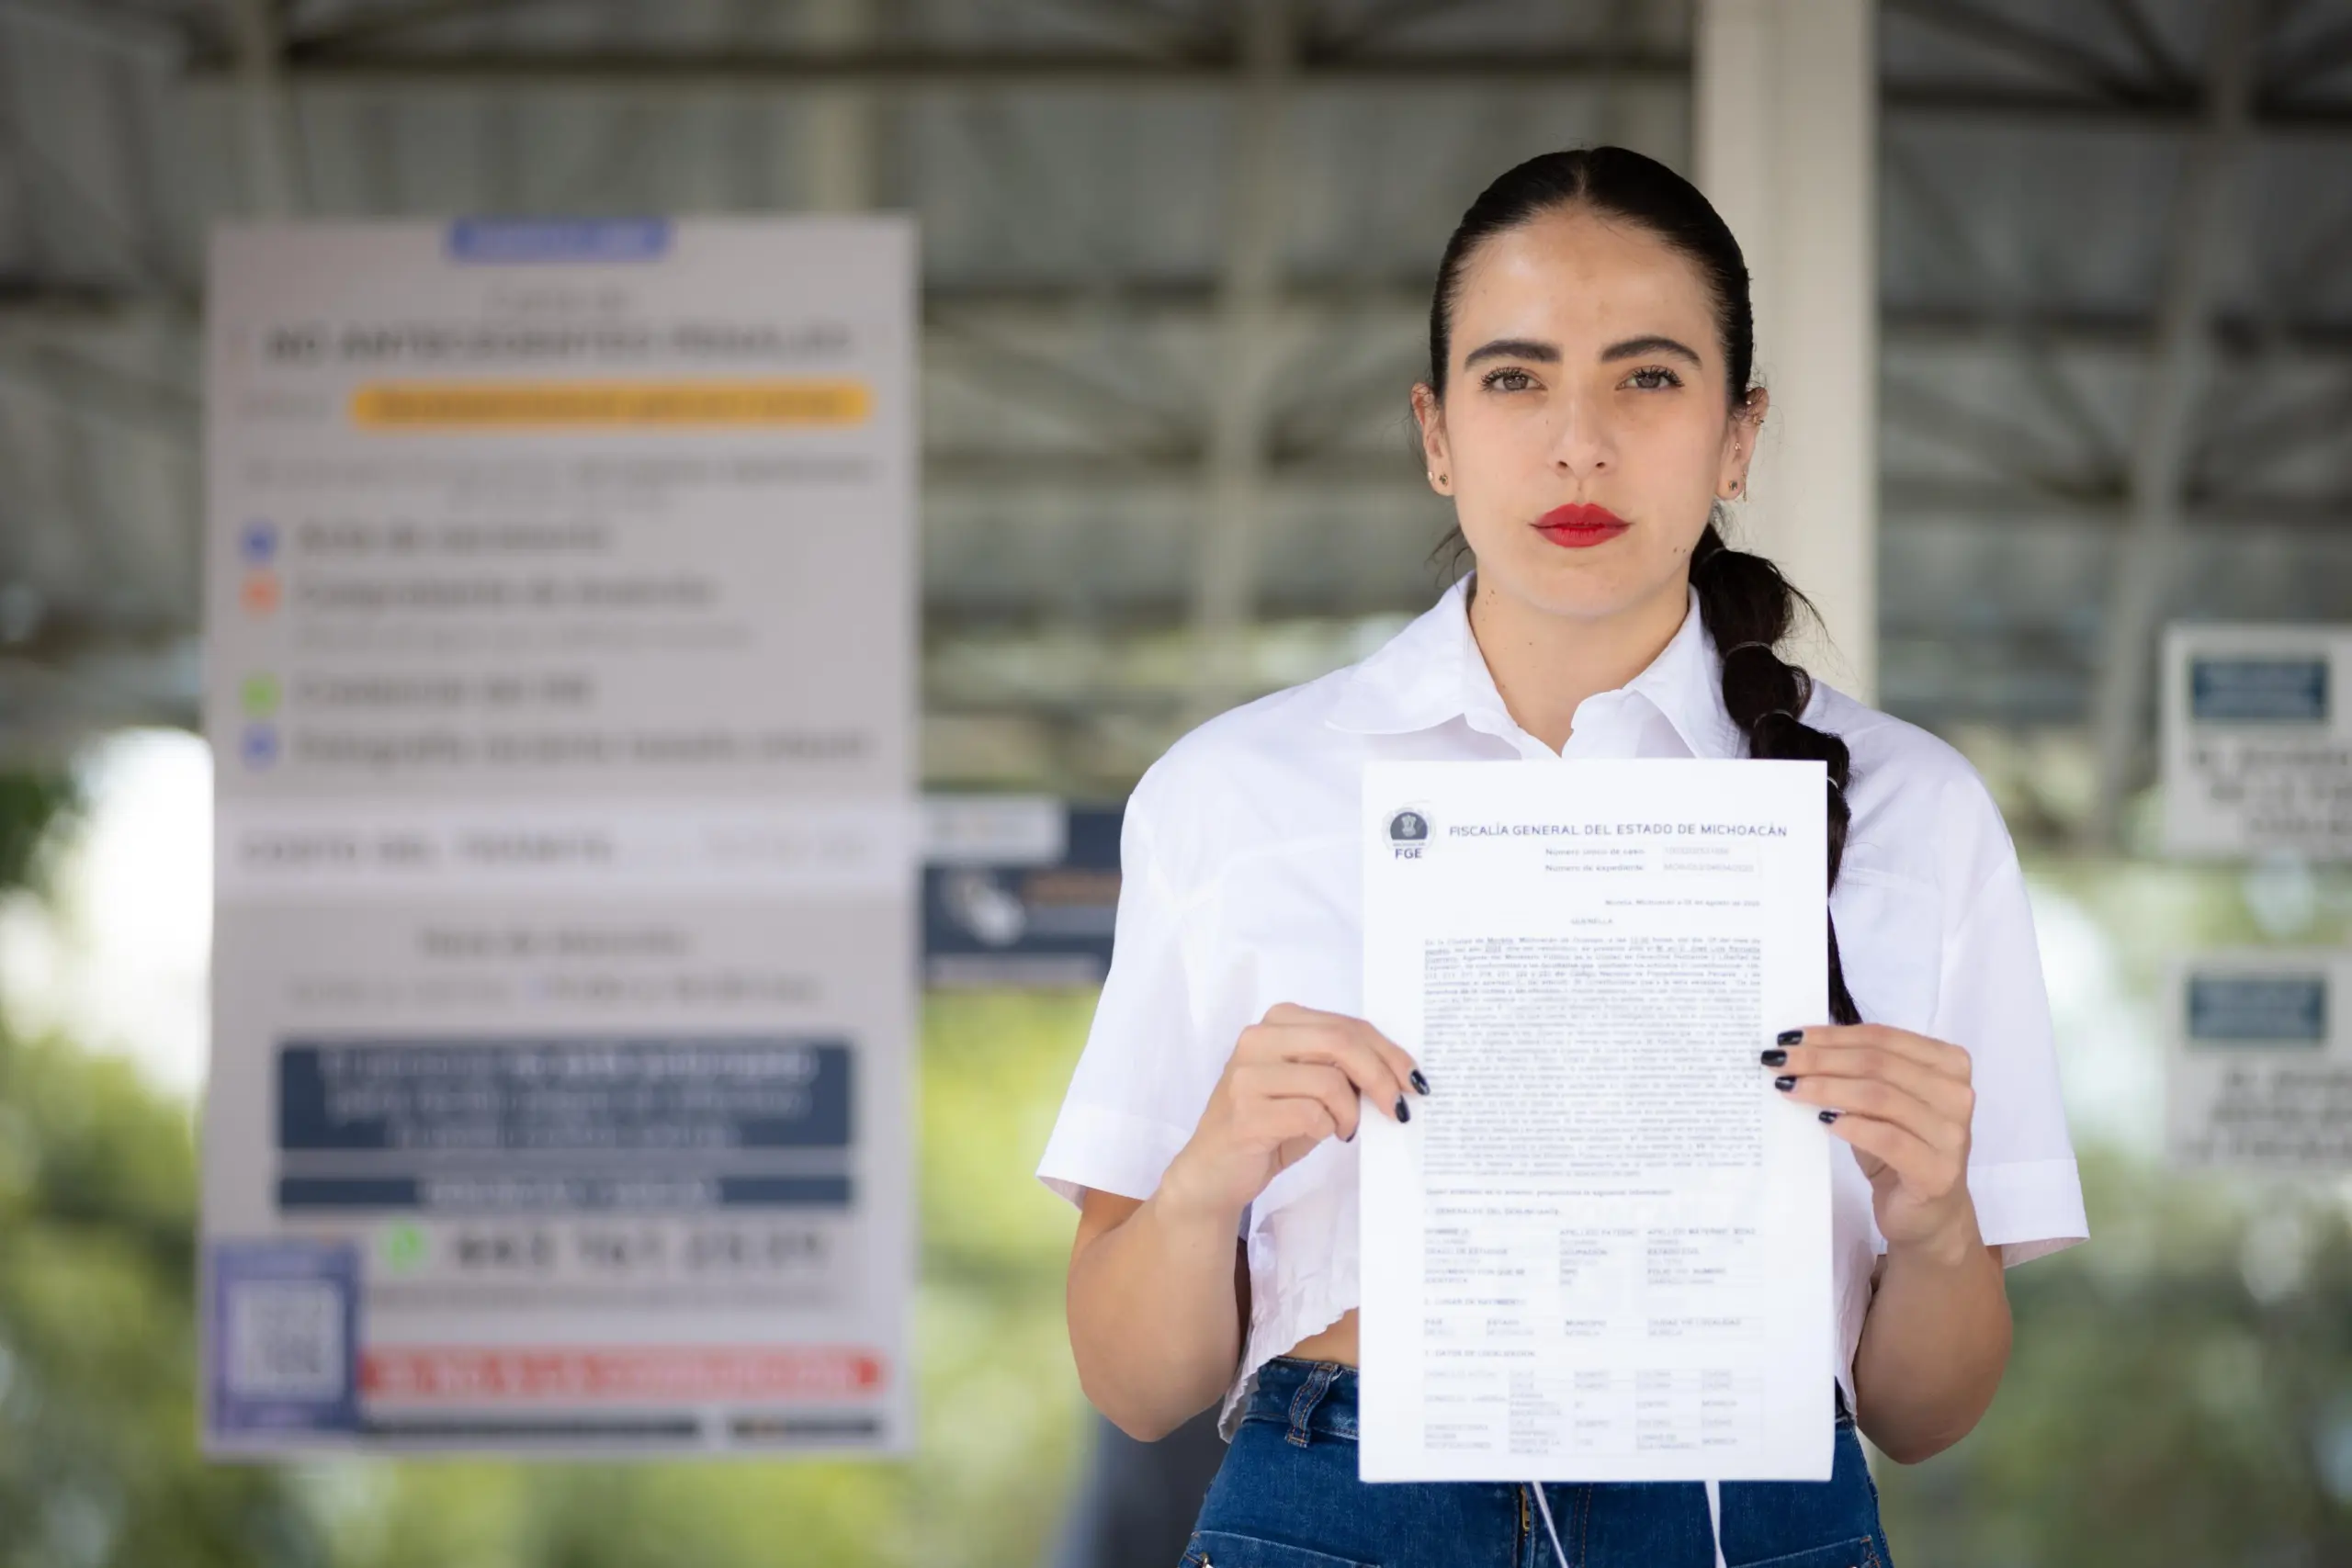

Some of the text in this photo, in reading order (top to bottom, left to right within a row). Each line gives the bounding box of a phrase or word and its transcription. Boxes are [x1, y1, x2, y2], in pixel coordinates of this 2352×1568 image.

[1449, 822, 1788, 838] FISCALÍA GENERAL DEL ESTADO DE MICHOACÁN
[1395, 848, 1423, 860] FGE
